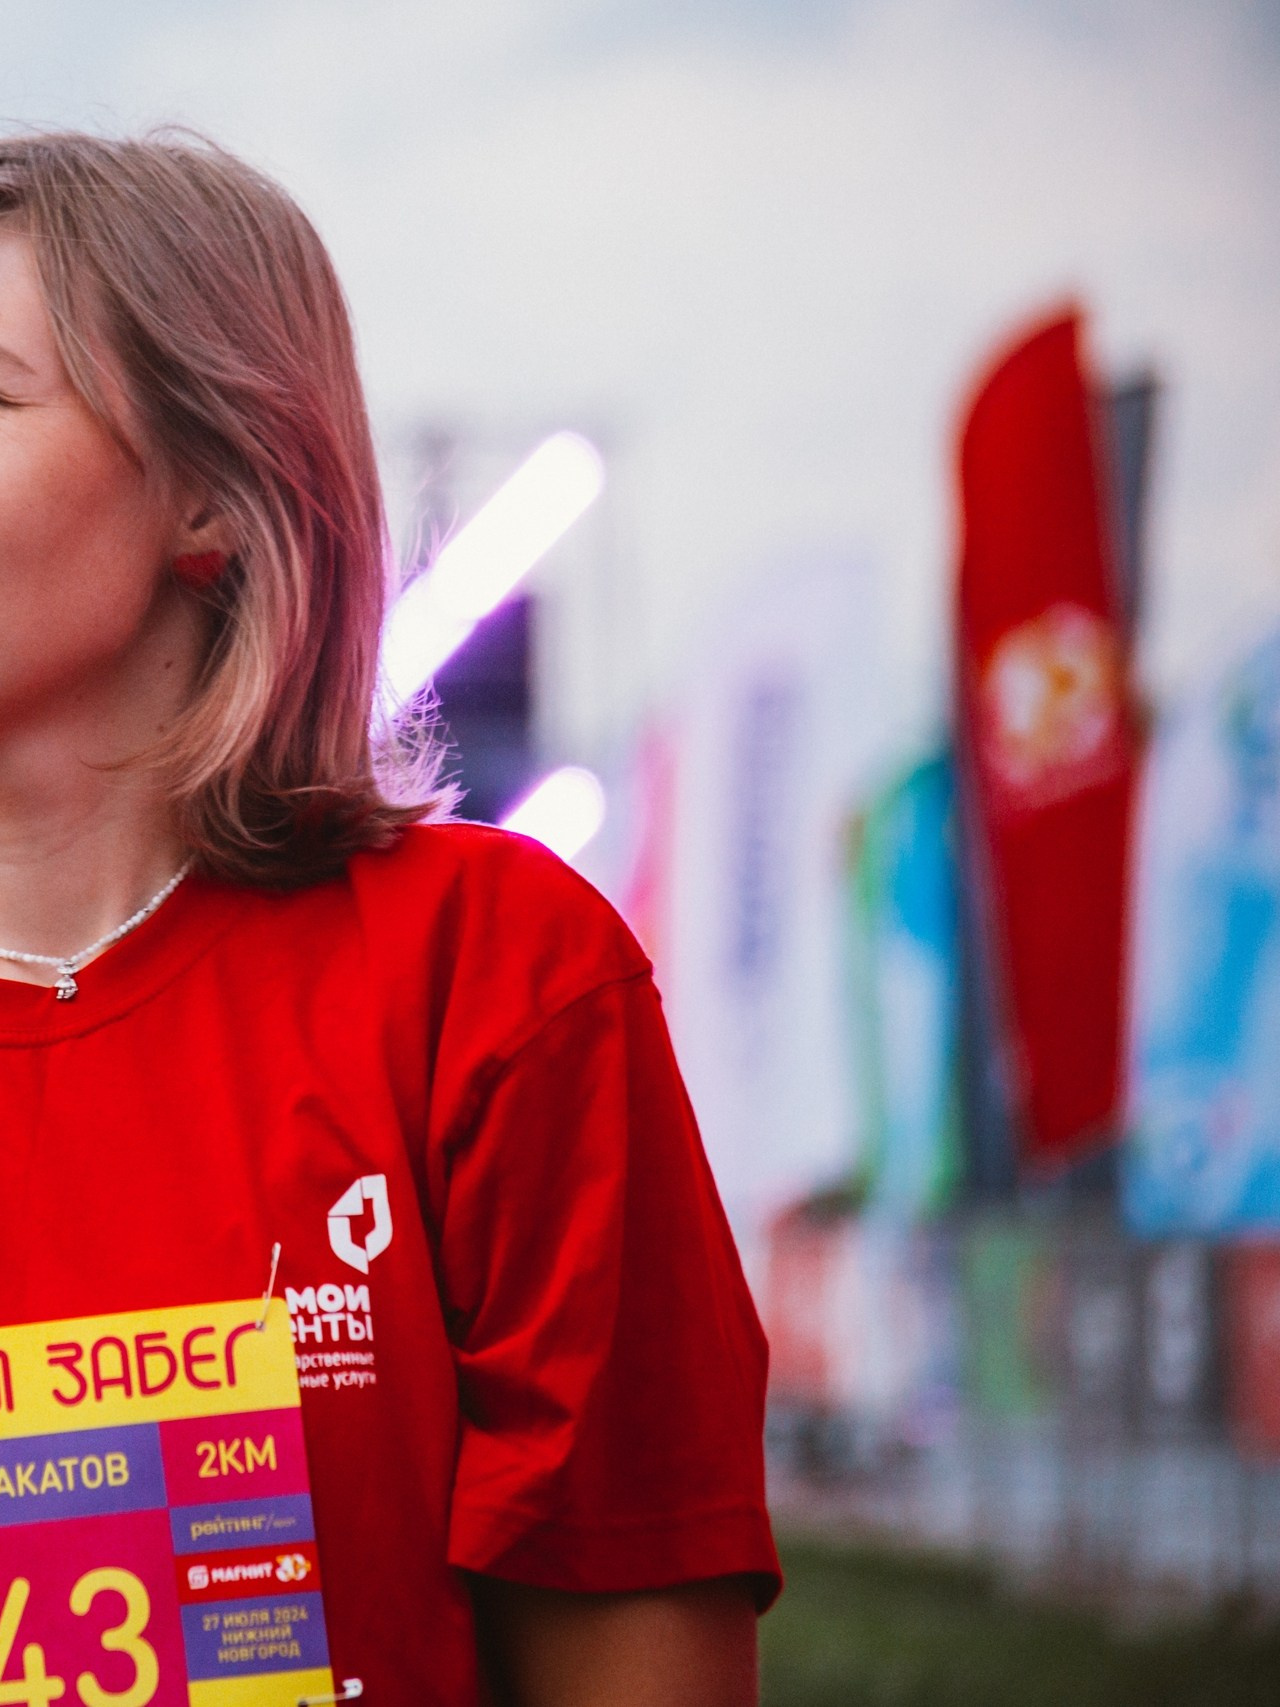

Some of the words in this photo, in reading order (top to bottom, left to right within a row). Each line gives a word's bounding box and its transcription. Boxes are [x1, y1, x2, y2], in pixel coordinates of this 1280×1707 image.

[46, 1321, 264, 1407] ЗАБЕГ
[195, 1434, 278, 1479] 2КМ
[211, 1562, 273, 1583] МАГНИТ
[202, 1614, 219, 1631] 27
[223, 1608, 270, 1629] ИЮЛЯ
[273, 1605, 309, 1623] 2024
[222, 1624, 293, 1645] НИЖНИЙ
[218, 1640, 301, 1664] НОВГОРОД
